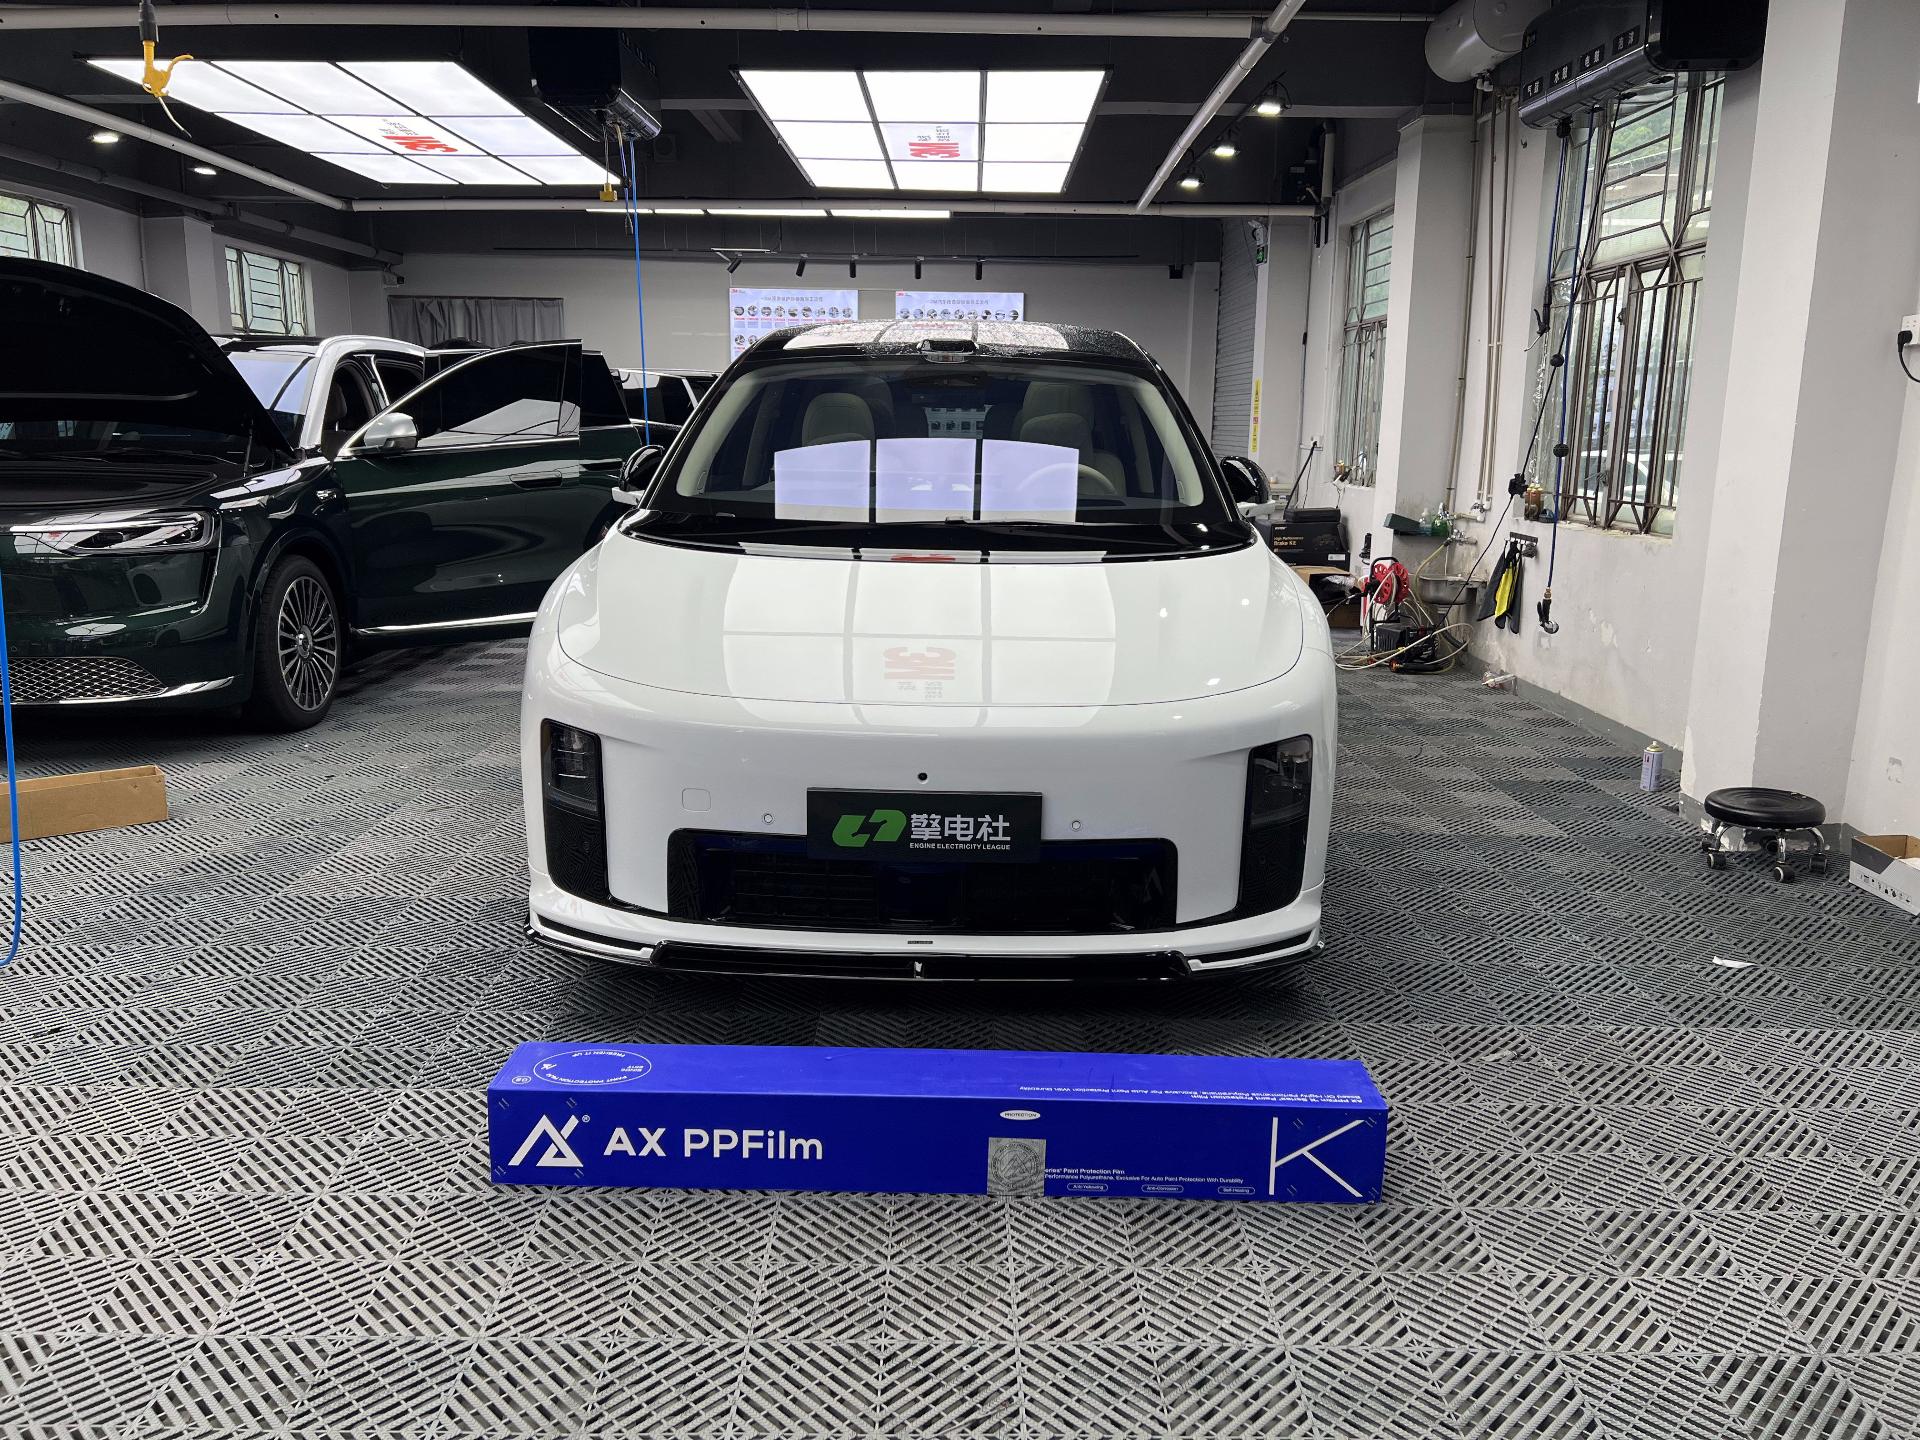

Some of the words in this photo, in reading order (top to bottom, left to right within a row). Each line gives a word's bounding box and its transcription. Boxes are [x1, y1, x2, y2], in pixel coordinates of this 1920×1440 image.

[908, 142, 961, 158] 3M
[910, 813, 1011, 841] 擎电社
[603, 1127, 667, 1157] AX
[683, 1128, 823, 1160] PPFilm
[1268, 1116, 1365, 1197] K
